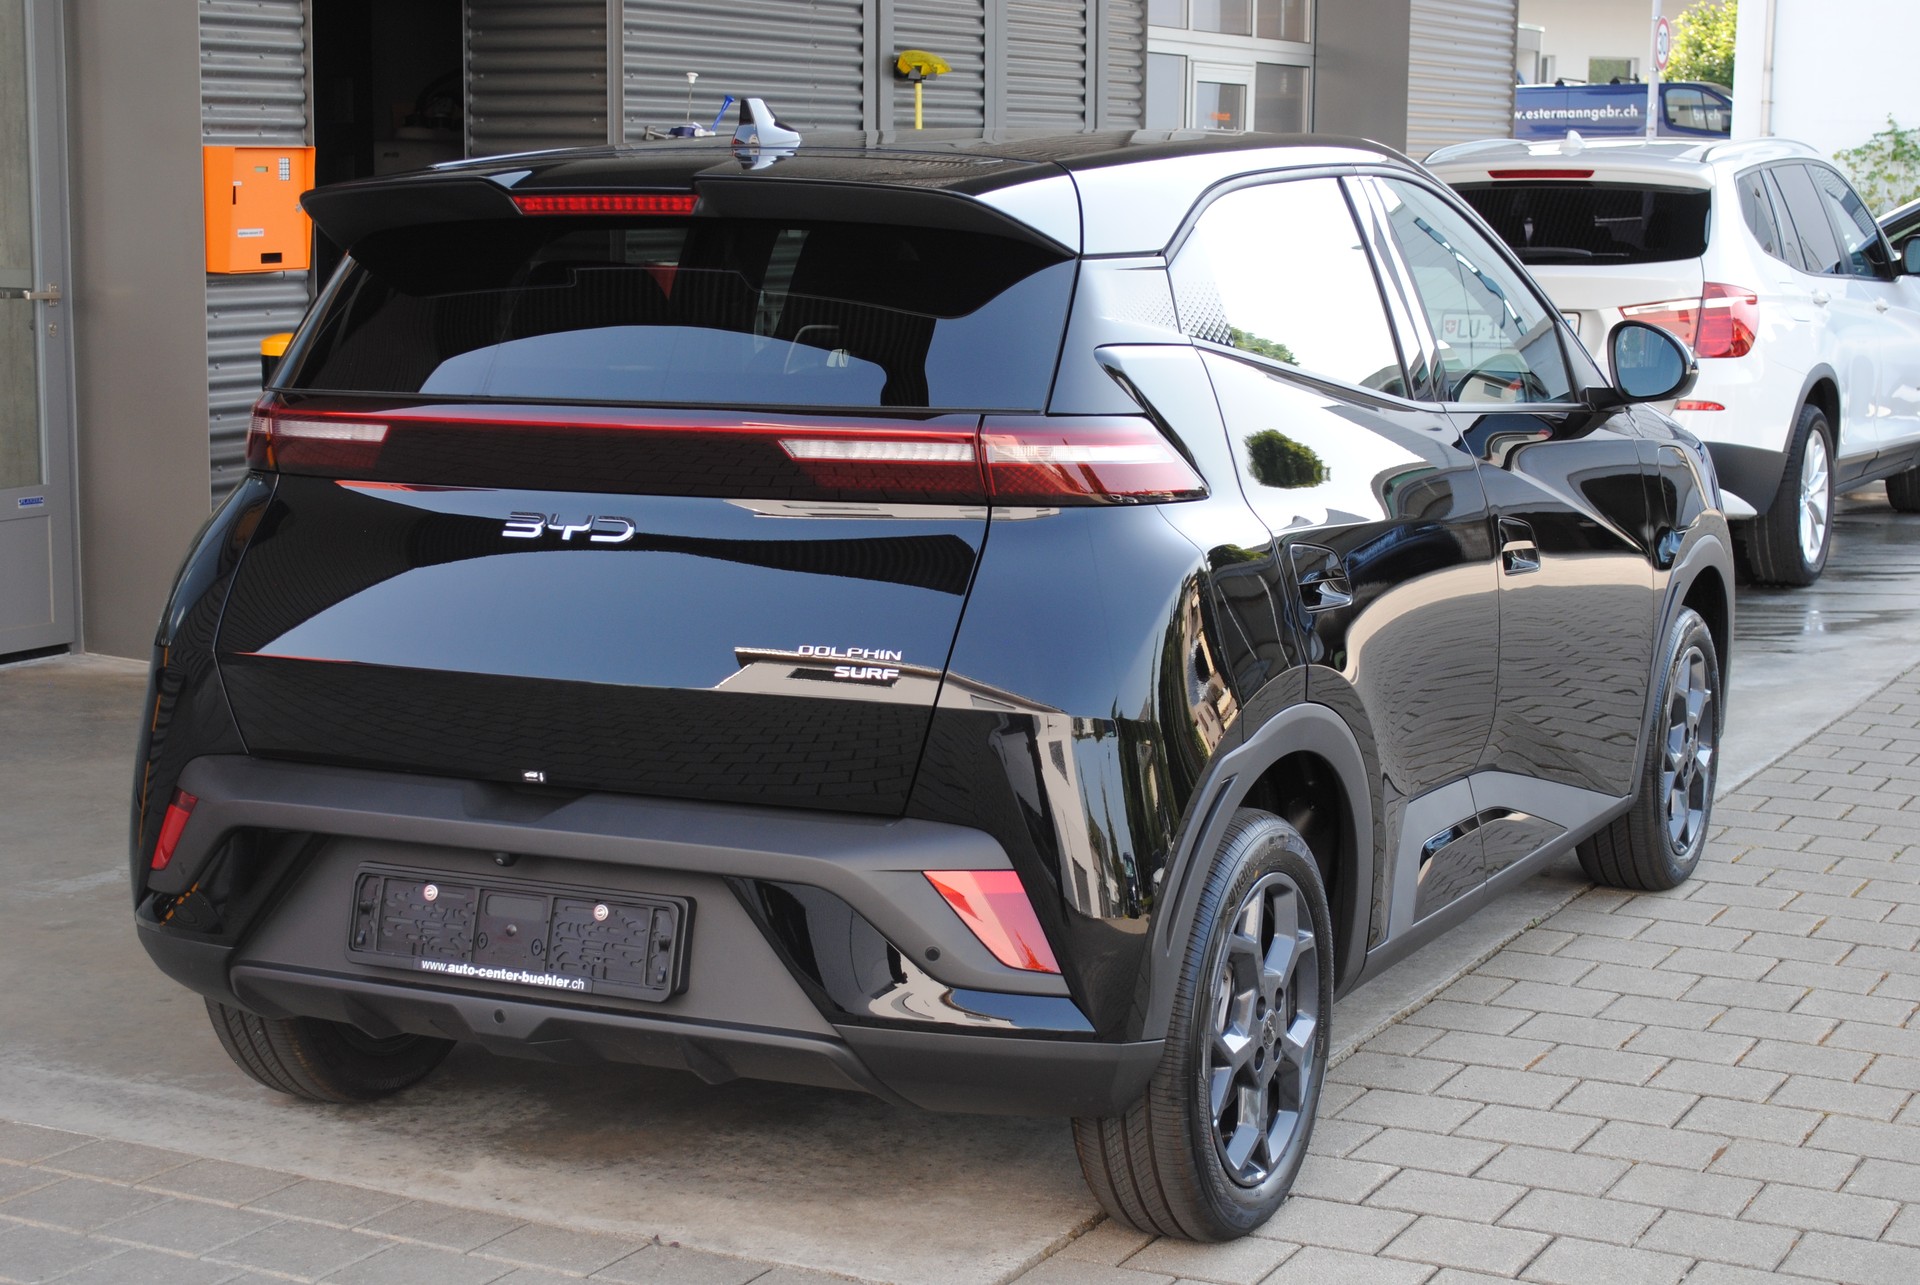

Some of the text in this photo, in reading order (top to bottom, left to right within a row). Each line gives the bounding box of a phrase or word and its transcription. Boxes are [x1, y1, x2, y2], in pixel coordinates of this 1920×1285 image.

[1658, 32, 1667, 55] 30
[502, 511, 636, 543] BYD
[798, 645, 902, 661] DOLPHIN
[834, 665, 899, 680] SURF
[421, 959, 585, 990] www.auto-center-buehler.ch
